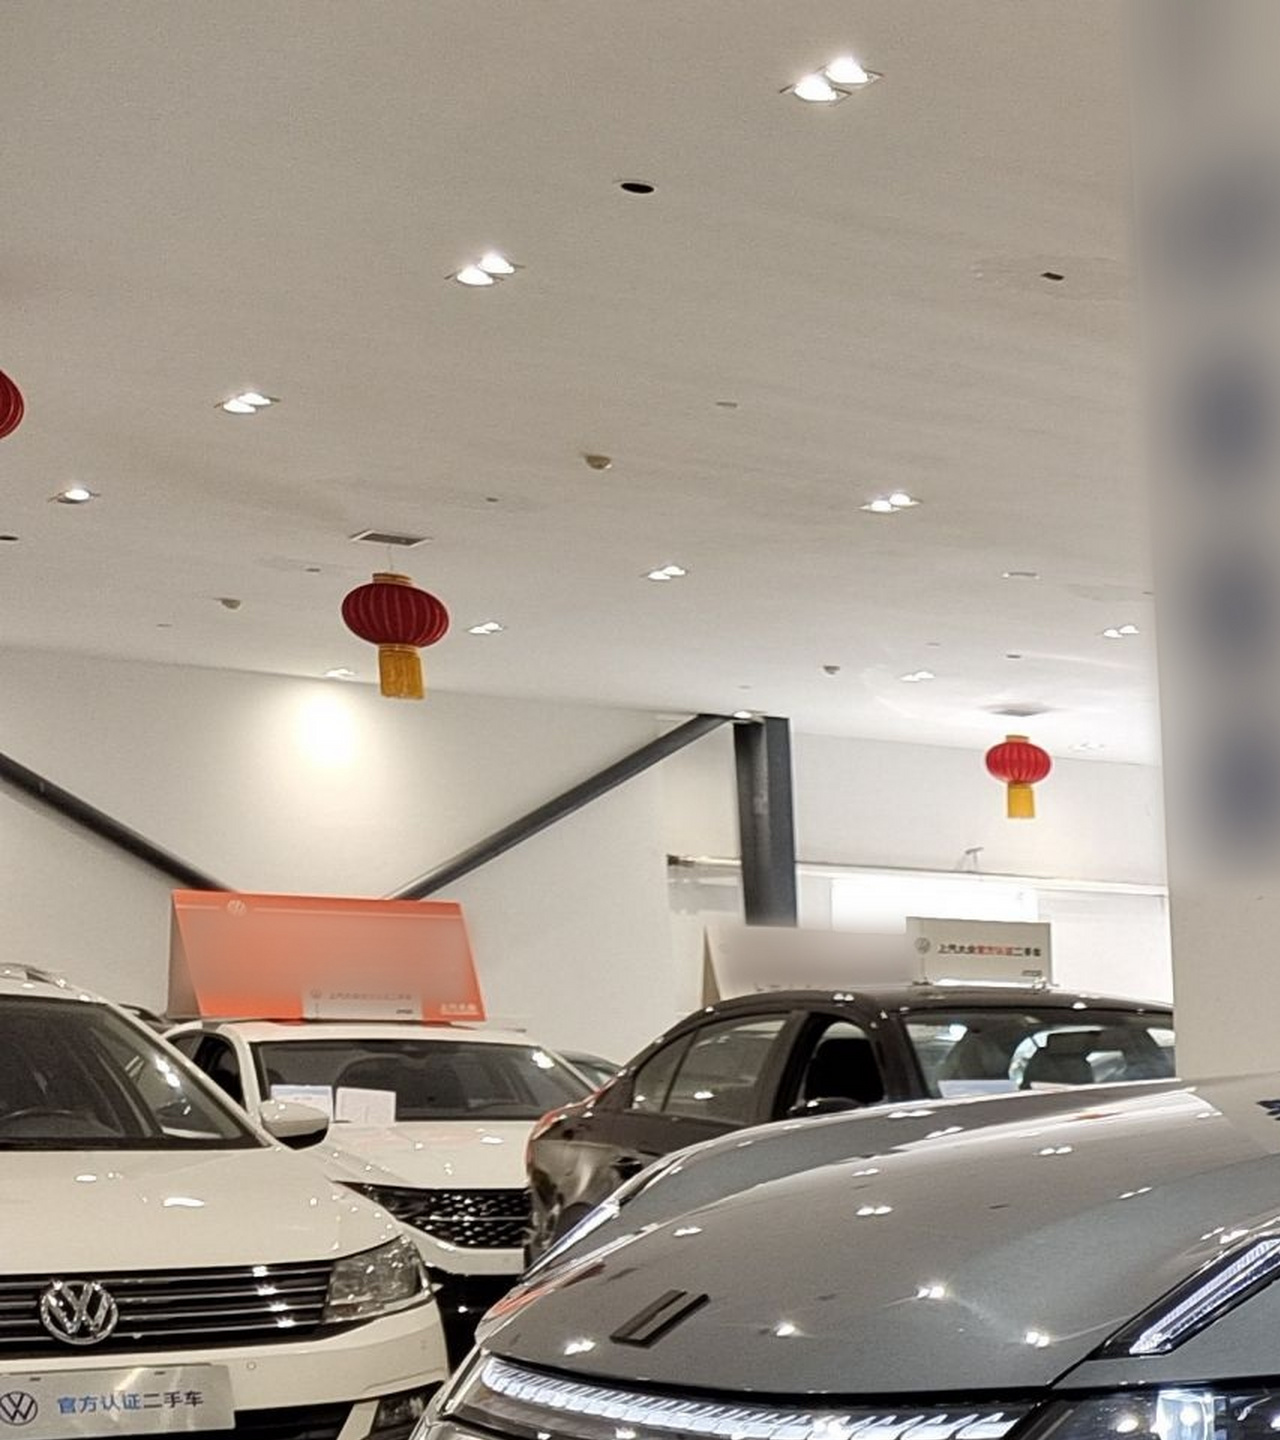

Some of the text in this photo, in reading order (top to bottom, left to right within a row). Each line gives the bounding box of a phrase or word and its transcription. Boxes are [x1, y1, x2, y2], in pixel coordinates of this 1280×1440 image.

[57, 1390, 204, 1415] 官方认证二手车
